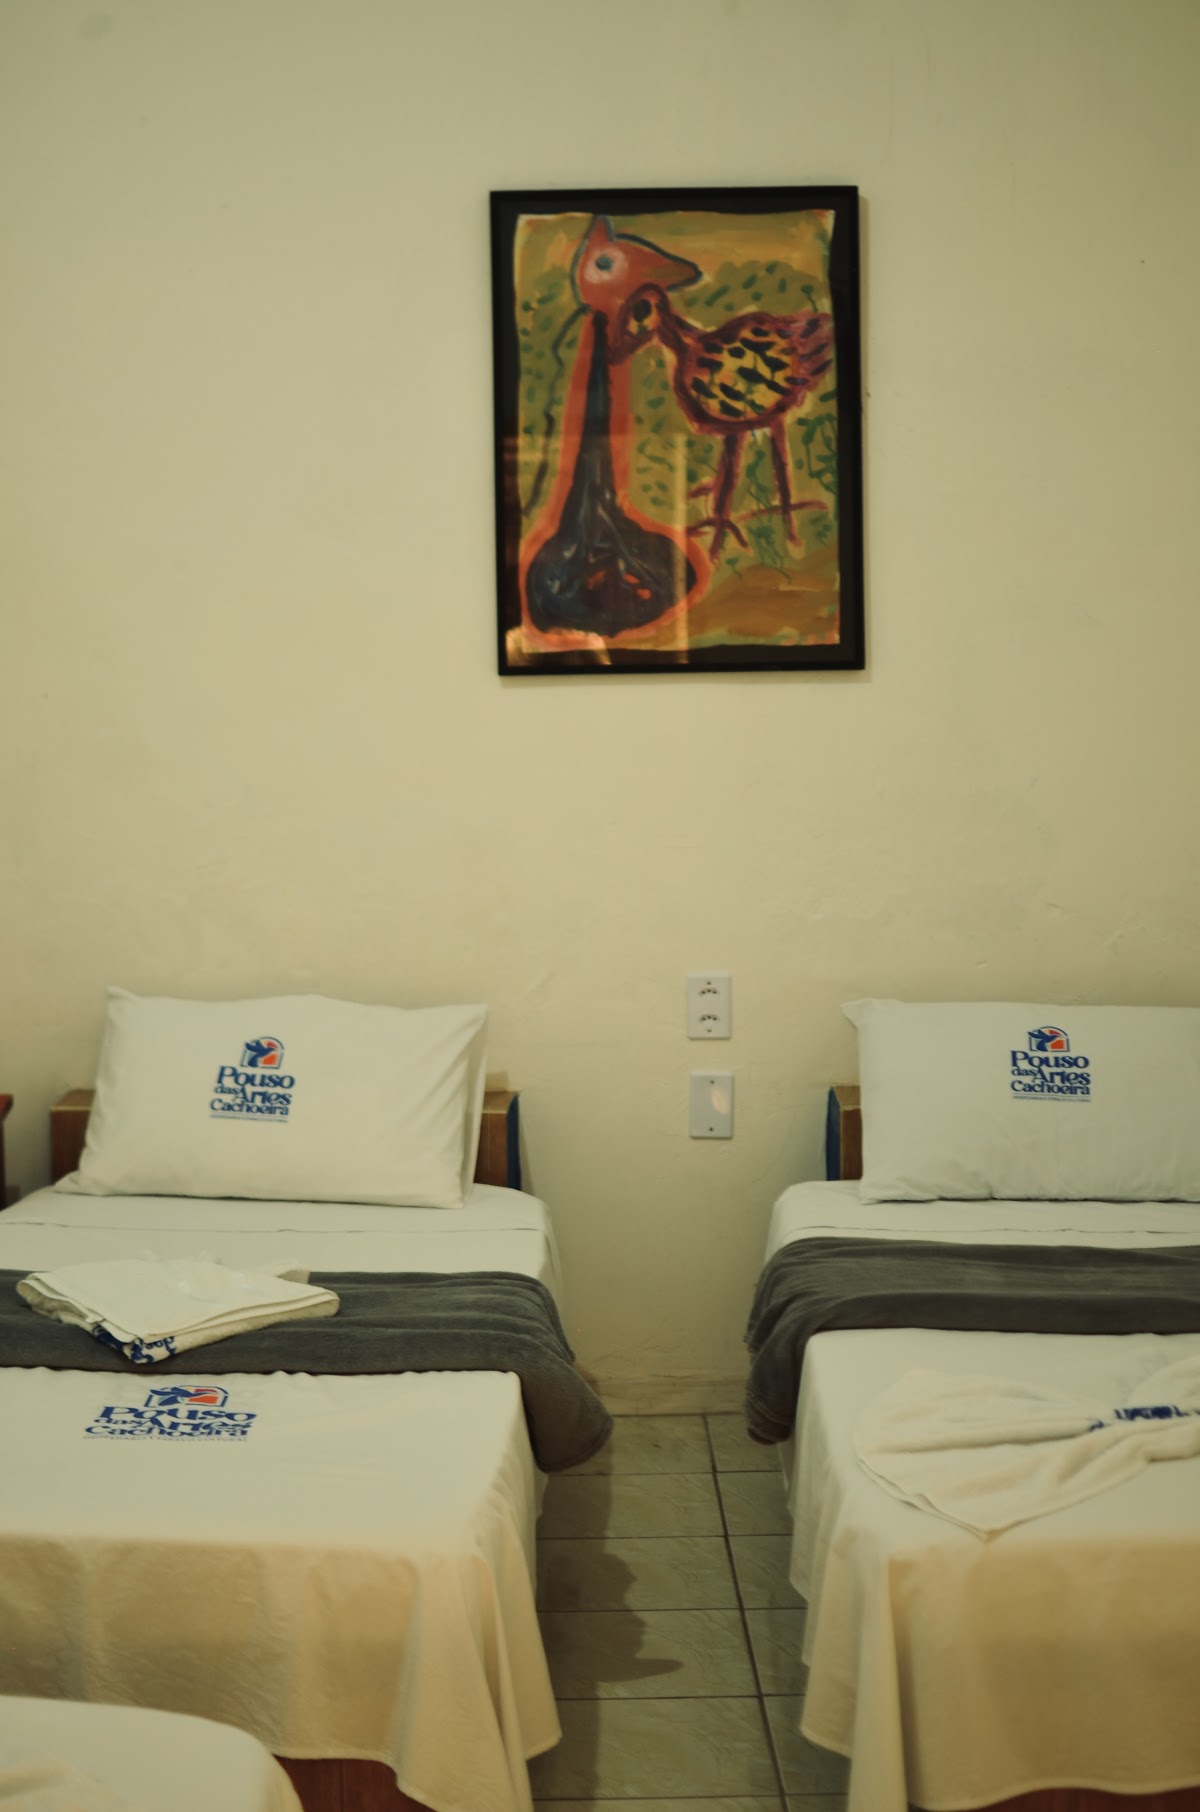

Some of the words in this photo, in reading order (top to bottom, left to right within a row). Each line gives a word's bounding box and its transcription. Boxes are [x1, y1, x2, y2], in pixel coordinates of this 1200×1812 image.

[1010, 1050, 1090, 1069] Pouso
[217, 1065, 295, 1089] Pouso
[1011, 1066, 1037, 1077] das
[1032, 1066, 1091, 1086] Artes
[214, 1084, 240, 1095] das
[232, 1085, 292, 1106] Artes
[1010, 1080, 1090, 1095] Cachoeira
[209, 1098, 289, 1115] Cachoeira
[100, 1406, 257, 1421] Pouso
[85, 1425, 248, 1437] Cachoeira
[94, 1416, 147, 1425] das
[131, 1417, 253, 1432] Artes
